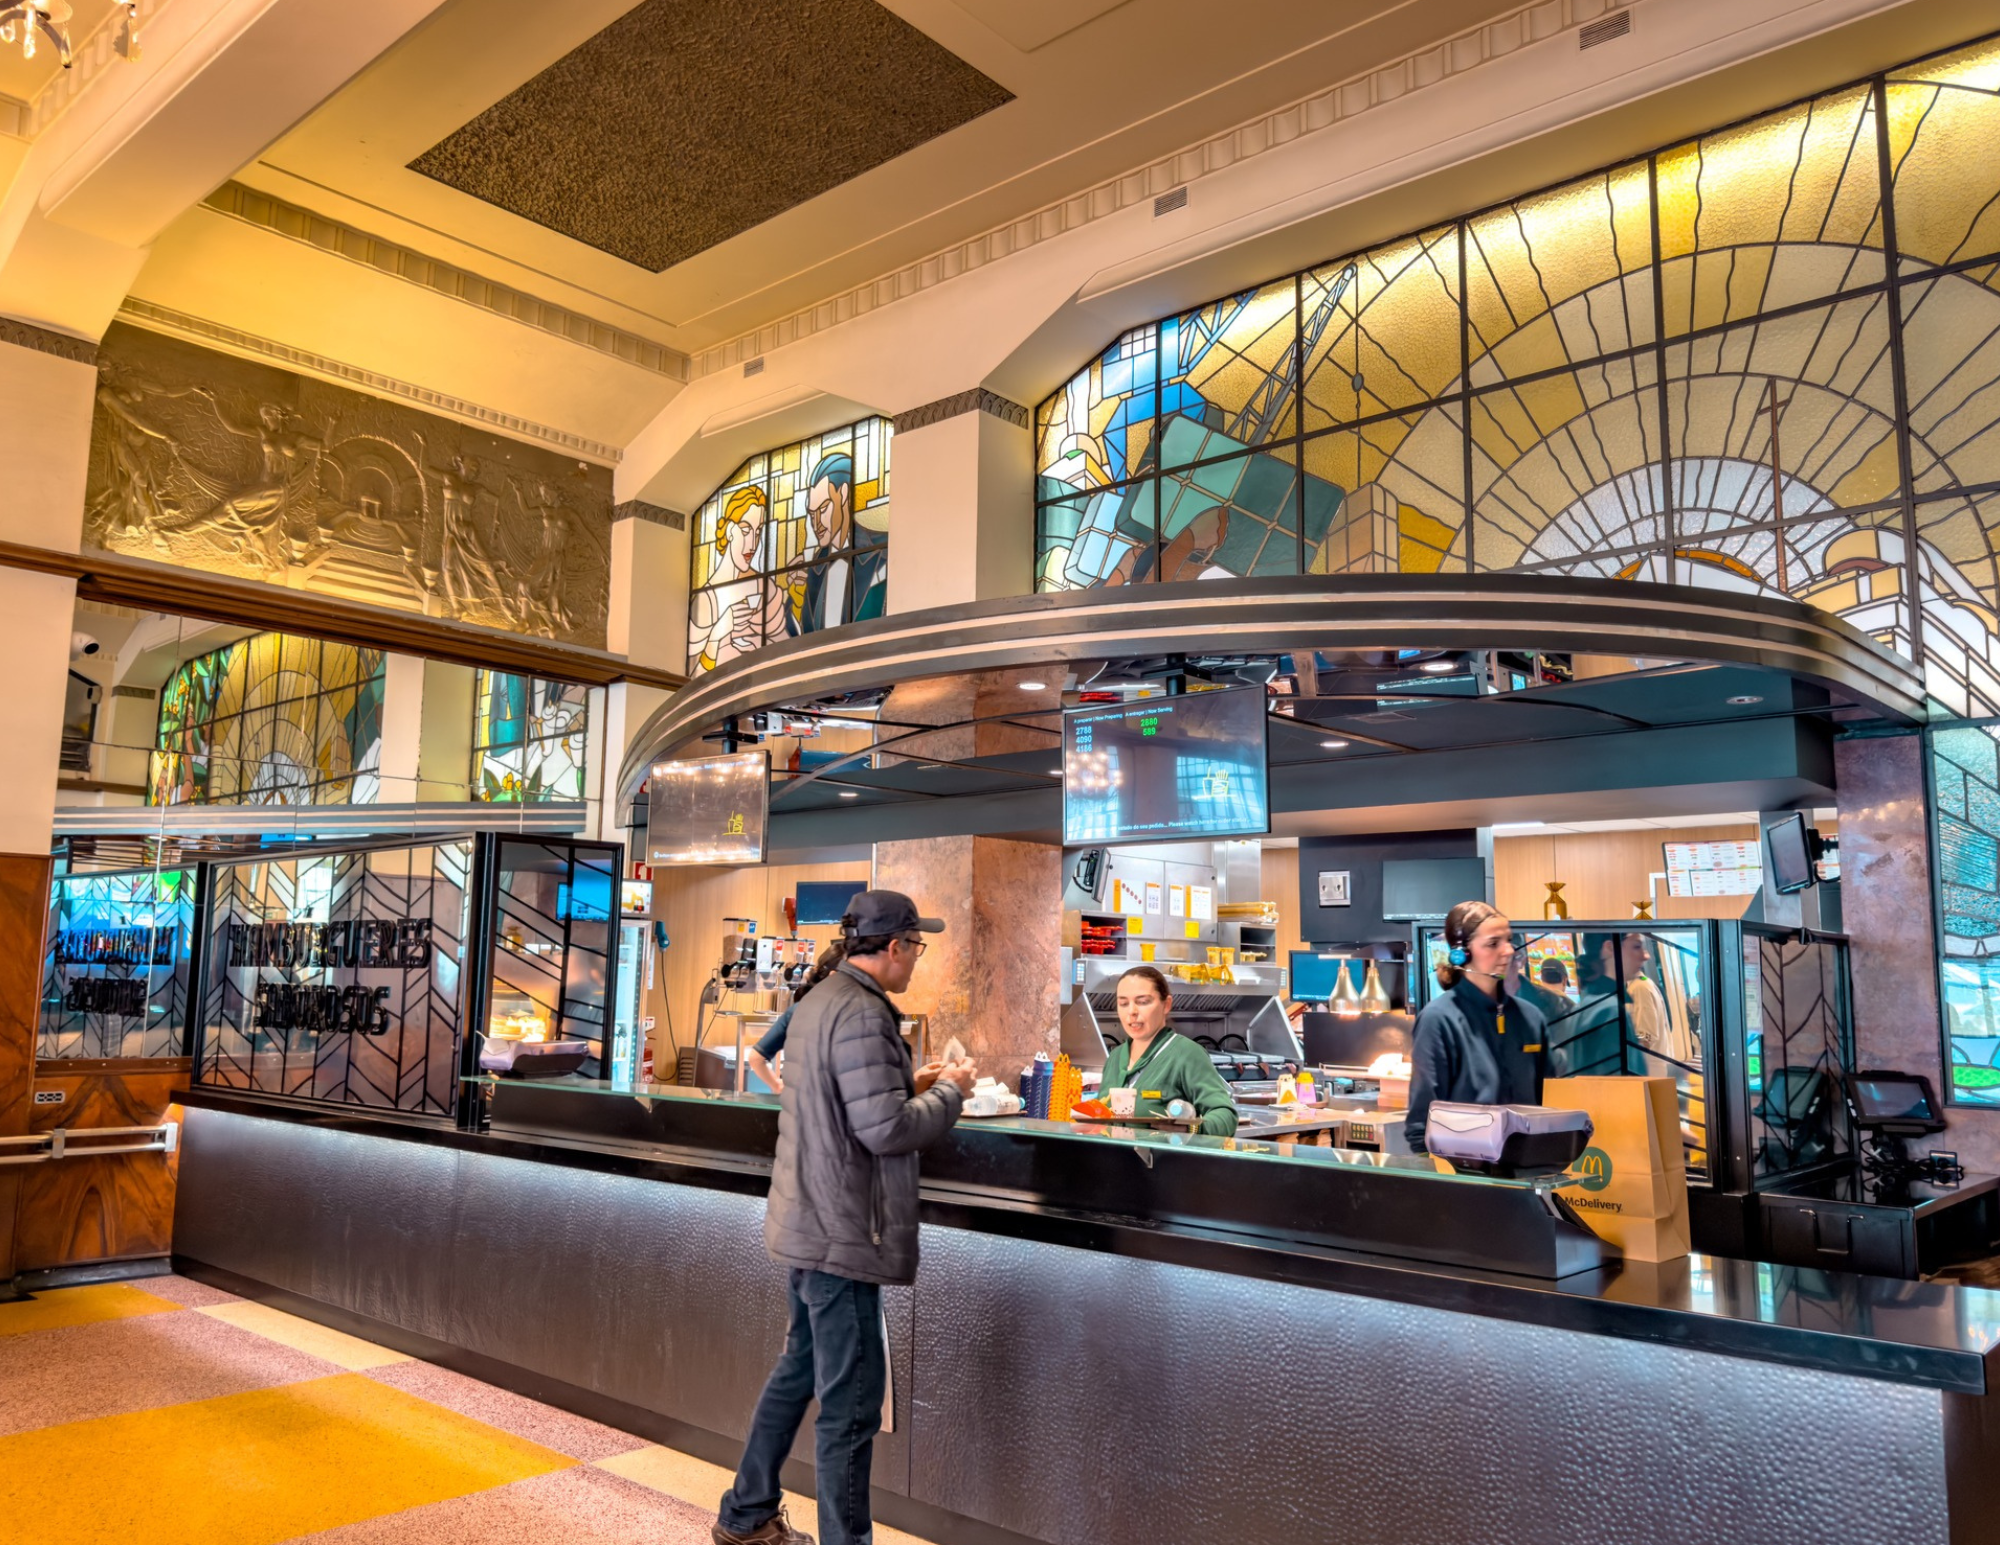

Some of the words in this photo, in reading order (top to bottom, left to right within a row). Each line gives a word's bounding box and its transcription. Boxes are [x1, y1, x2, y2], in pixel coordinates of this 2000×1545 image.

[1140, 717, 1157, 727] 2880
[1143, 727, 1156, 735] 589
[1076, 735, 1092, 743] 4090
[230, 918, 432, 968] HAMBURGUERES
[1564, 1196, 1622, 1213] McDelivery
